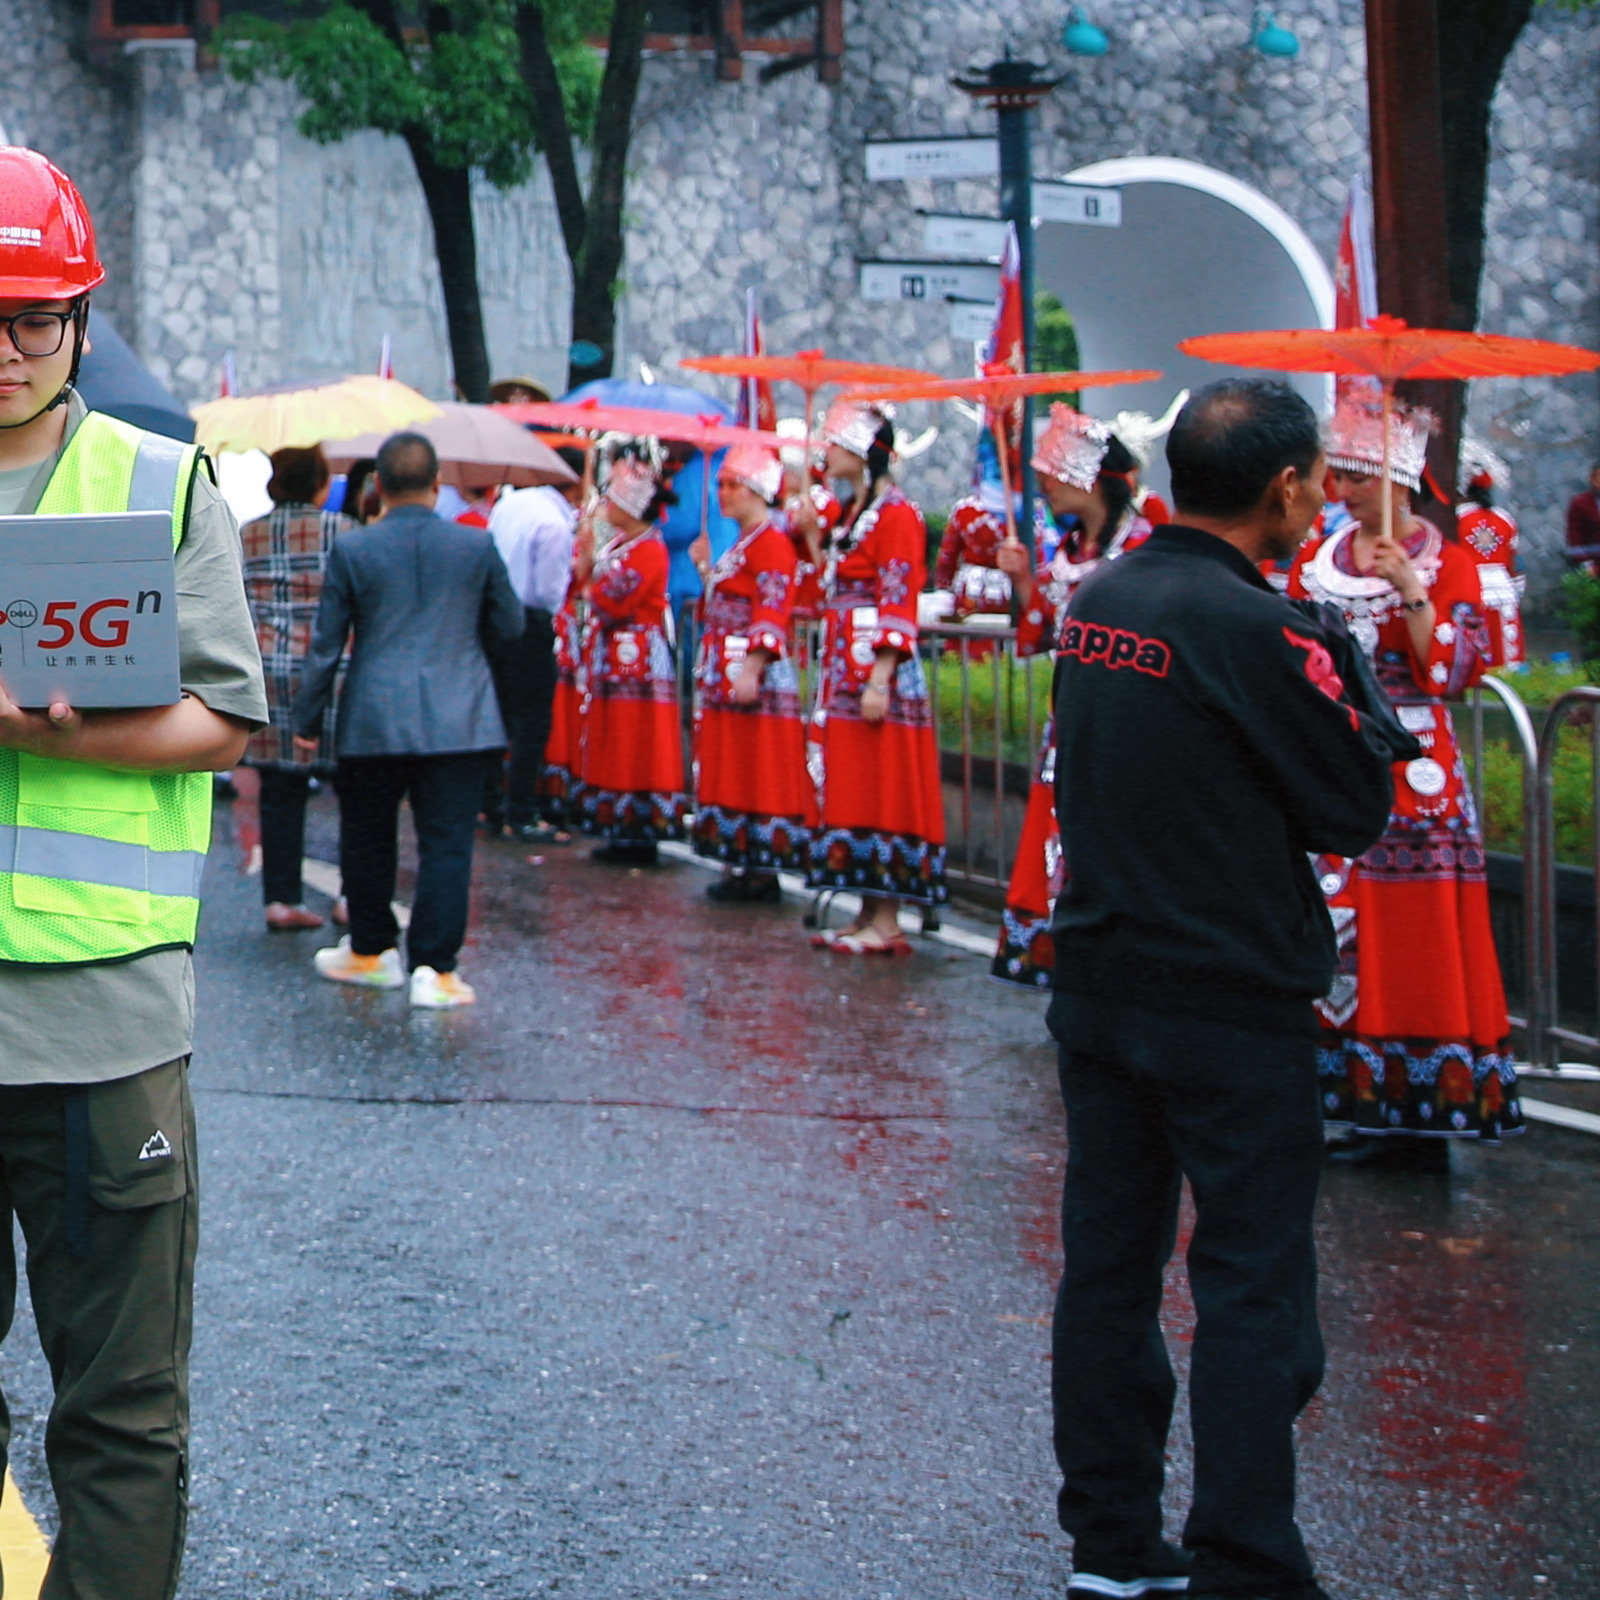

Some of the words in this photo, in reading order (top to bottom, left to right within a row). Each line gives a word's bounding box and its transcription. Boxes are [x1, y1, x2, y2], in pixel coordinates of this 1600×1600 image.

[46, 654, 136, 667] 让未来生长
[1057, 616, 1172, 678] appa
